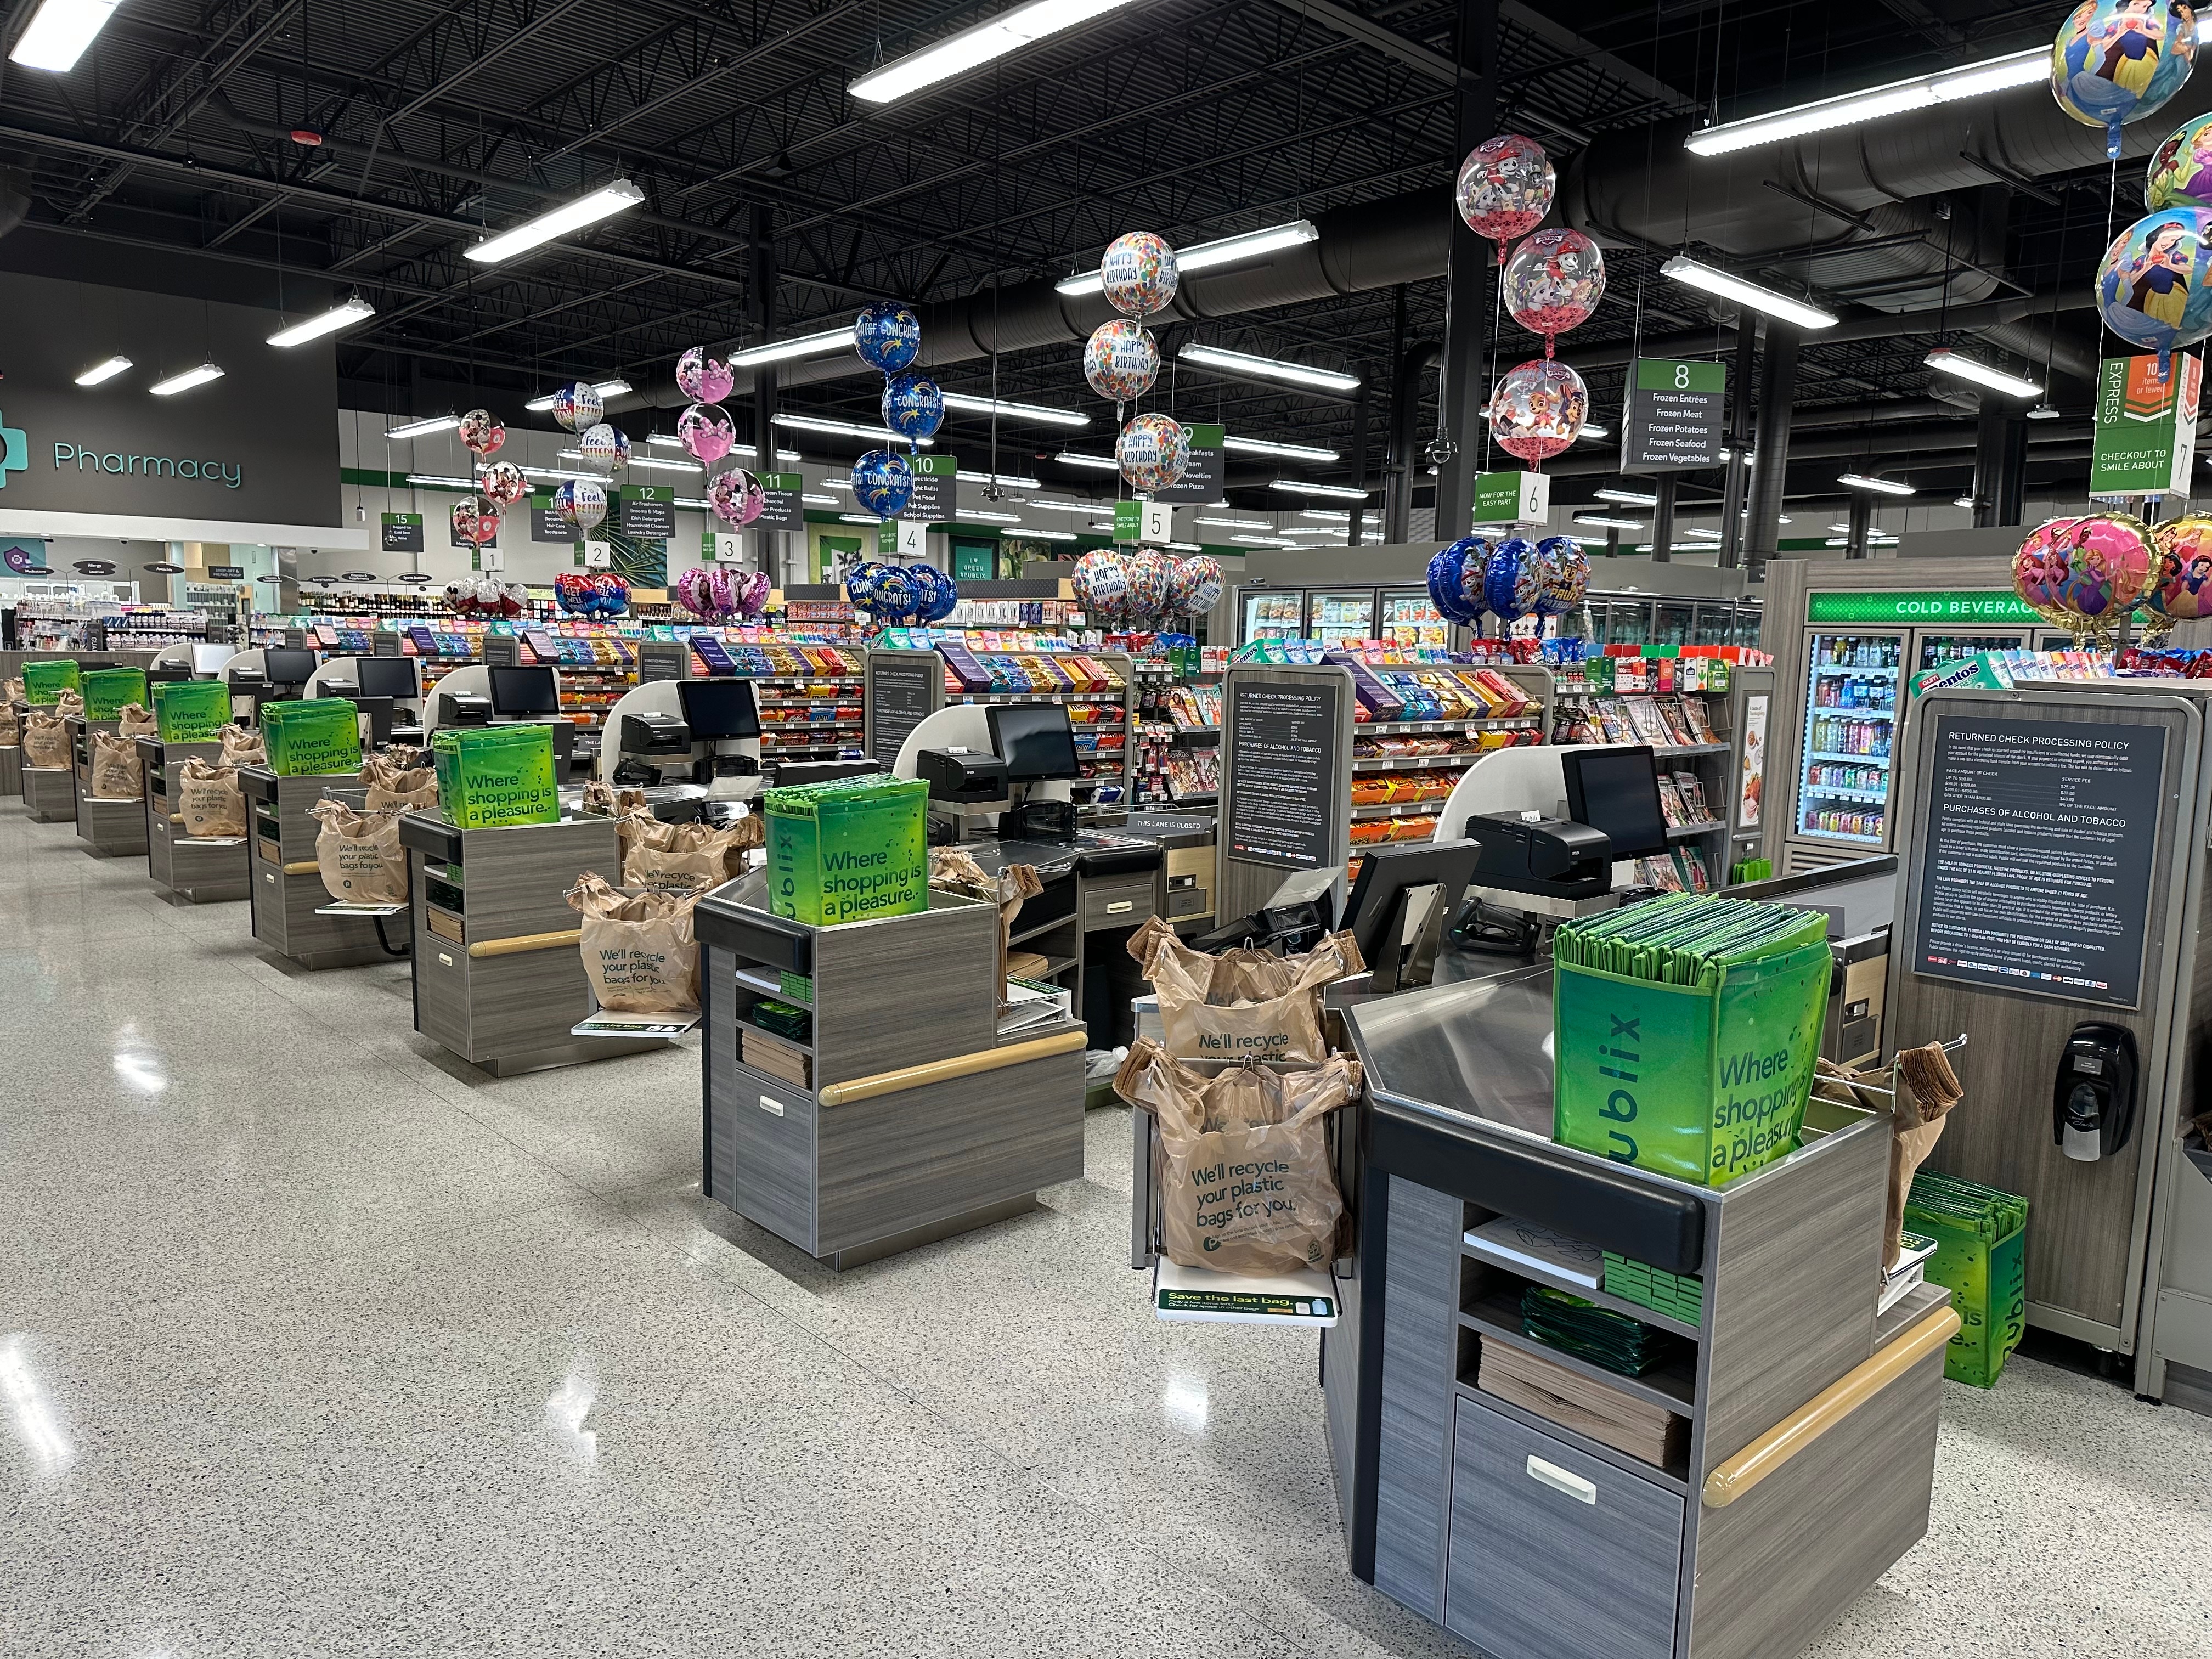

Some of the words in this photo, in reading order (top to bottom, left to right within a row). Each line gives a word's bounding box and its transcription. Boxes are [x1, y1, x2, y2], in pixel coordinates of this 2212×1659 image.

[1110, 252, 1132, 266] HAPPY
[1106, 267, 1137, 283] BIRTHDAY
[1121, 340, 1145, 354] HAPPY
[1115, 356, 1148, 371] BIRTHDAY
[2146, 363, 2157, 375] 10
[1674, 364, 1689, 388] 8
[1653, 393, 1678, 402] Frozen
[1680, 394, 1707, 404] Entrées
[2104, 363, 2123, 424] EXPRESS
[582, 394, 600, 407] Feel
[1657, 409, 1681, 417] Frozen
[1683, 410, 1702, 418] Meat
[1649, 424, 1673, 432] Frozen
[1675, 425, 1707, 433] Potatoes
[1649, 438, 1674, 447] Frozen
[1675, 439, 1706, 448] Seafood
[1125, 450, 1156, 462] BIRTHDAY
[1669, 453, 1710, 464] Vegetables
[2101, 450, 2152, 460] CHECKOUT
[2181, 443, 2187, 479] 7
[54, 442, 241, 488] Pharmacy
[916, 458, 933, 473] 10
[2101, 463, 2129, 471] SMILE
[2131, 461, 2164, 470] ABOUT
[766, 475, 780, 488] 11
[582, 492, 601, 502] Feel
[639, 487, 655, 500] 12
[1530, 486, 1538, 512] 6
[395, 515, 407, 524] 15
[1152, 513, 1161, 534] 5
[907, 531, 916, 548] 4
[594, 548, 601, 561] 2
[725, 541, 733, 556] 3
[490, 554, 494, 566] 1
[565, 585, 580, 596] GET
[1548, 588, 1574, 601] PAW
[1896, 601, 1942, 613] COLD
[1949, 601, 2033, 613] BEVERAG
[1922, 675, 1939, 686] GUM
[1960, 676, 1977, 688] FRESH
[1658, 702, 1676, 710] JESUS
[172, 721, 221, 732] shopping
[288, 739, 330, 750] Where
[1269, 743, 1289, 752] ALCOHOL
[1949, 732, 1996, 742] RETURNED
[1999, 735, 2030, 744] CHECK
[2032, 737, 2092, 748] PROCESSING
[2095, 741, 2129, 750] POLICY
[290, 747, 348, 762] shopping
[466, 775, 518, 789] Where
[468, 788, 539, 806] shopping
[542, 787, 551, 797] is
[470, 811, 478, 820] a
[482, 804, 547, 823] pleasure.
[1943, 804, 1995, 815] PURCHASES
[2012, 810, 2055, 821] ALCOHOL
[2057, 814, 2078, 823] AND
[2080, 816, 2126, 827] TOBACCO
[340, 862, 358, 871] bags
[823, 851, 887, 871] Where
[777, 835, 796, 919] ublix
[823, 868, 907, 895] shopping
[911, 865, 921, 878] is
[825, 902, 835, 916] a
[840, 889, 915, 919] pleasure.
[600, 949, 625, 960] We'll
[603, 963, 627, 974] your
[603, 975, 630, 984] bags
[632, 973, 648, 983] for
[1237, 1031, 1289, 1051] recycle
[1719, 1048, 1788, 1089] Where
[1599, 1013, 1640, 1164] ublix
[1192, 1163, 1224, 1186] We'll
[1229, 1160, 1289, 1178] recycle
[1196, 1187, 1227, 1211] your
[1231, 1176, 1284, 1202] plastic
[1197, 1209, 1233, 1228] bags
[1261, 1297, 1293, 1306] bag.
